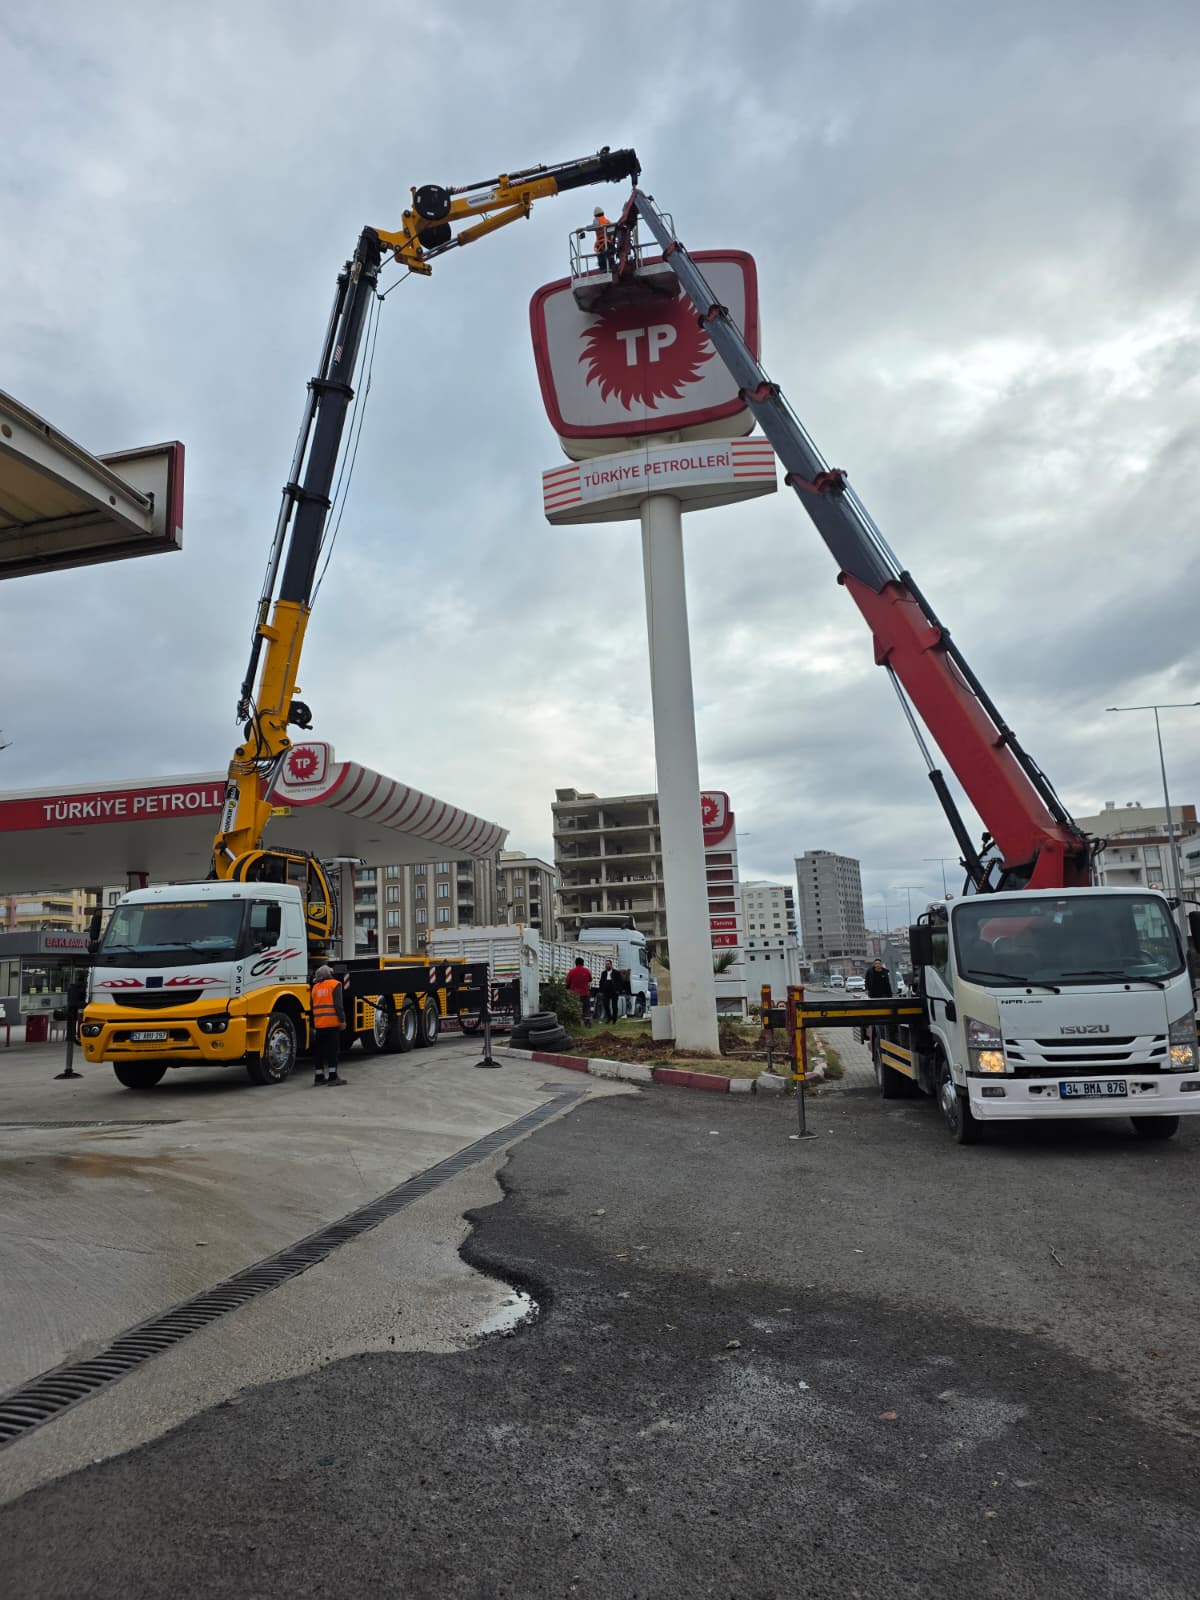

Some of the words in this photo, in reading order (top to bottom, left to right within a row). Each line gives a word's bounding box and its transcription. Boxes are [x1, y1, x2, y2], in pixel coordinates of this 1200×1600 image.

[616, 324, 677, 366] TP
[584, 465, 640, 487] TÜRKİYE
[644, 452, 730, 476] PETROLLERİ
[295, 758, 310, 769] TP
[43, 798, 127, 821] TÜRKİYE
[133, 790, 222, 814] PETROLL
[1060, 1024, 1110, 1035] ISUZU
[1066, 1083, 1079, 1095] 34
[1083, 1083, 1102, 1095] BMA
[1107, 1081, 1126, 1094] 876
